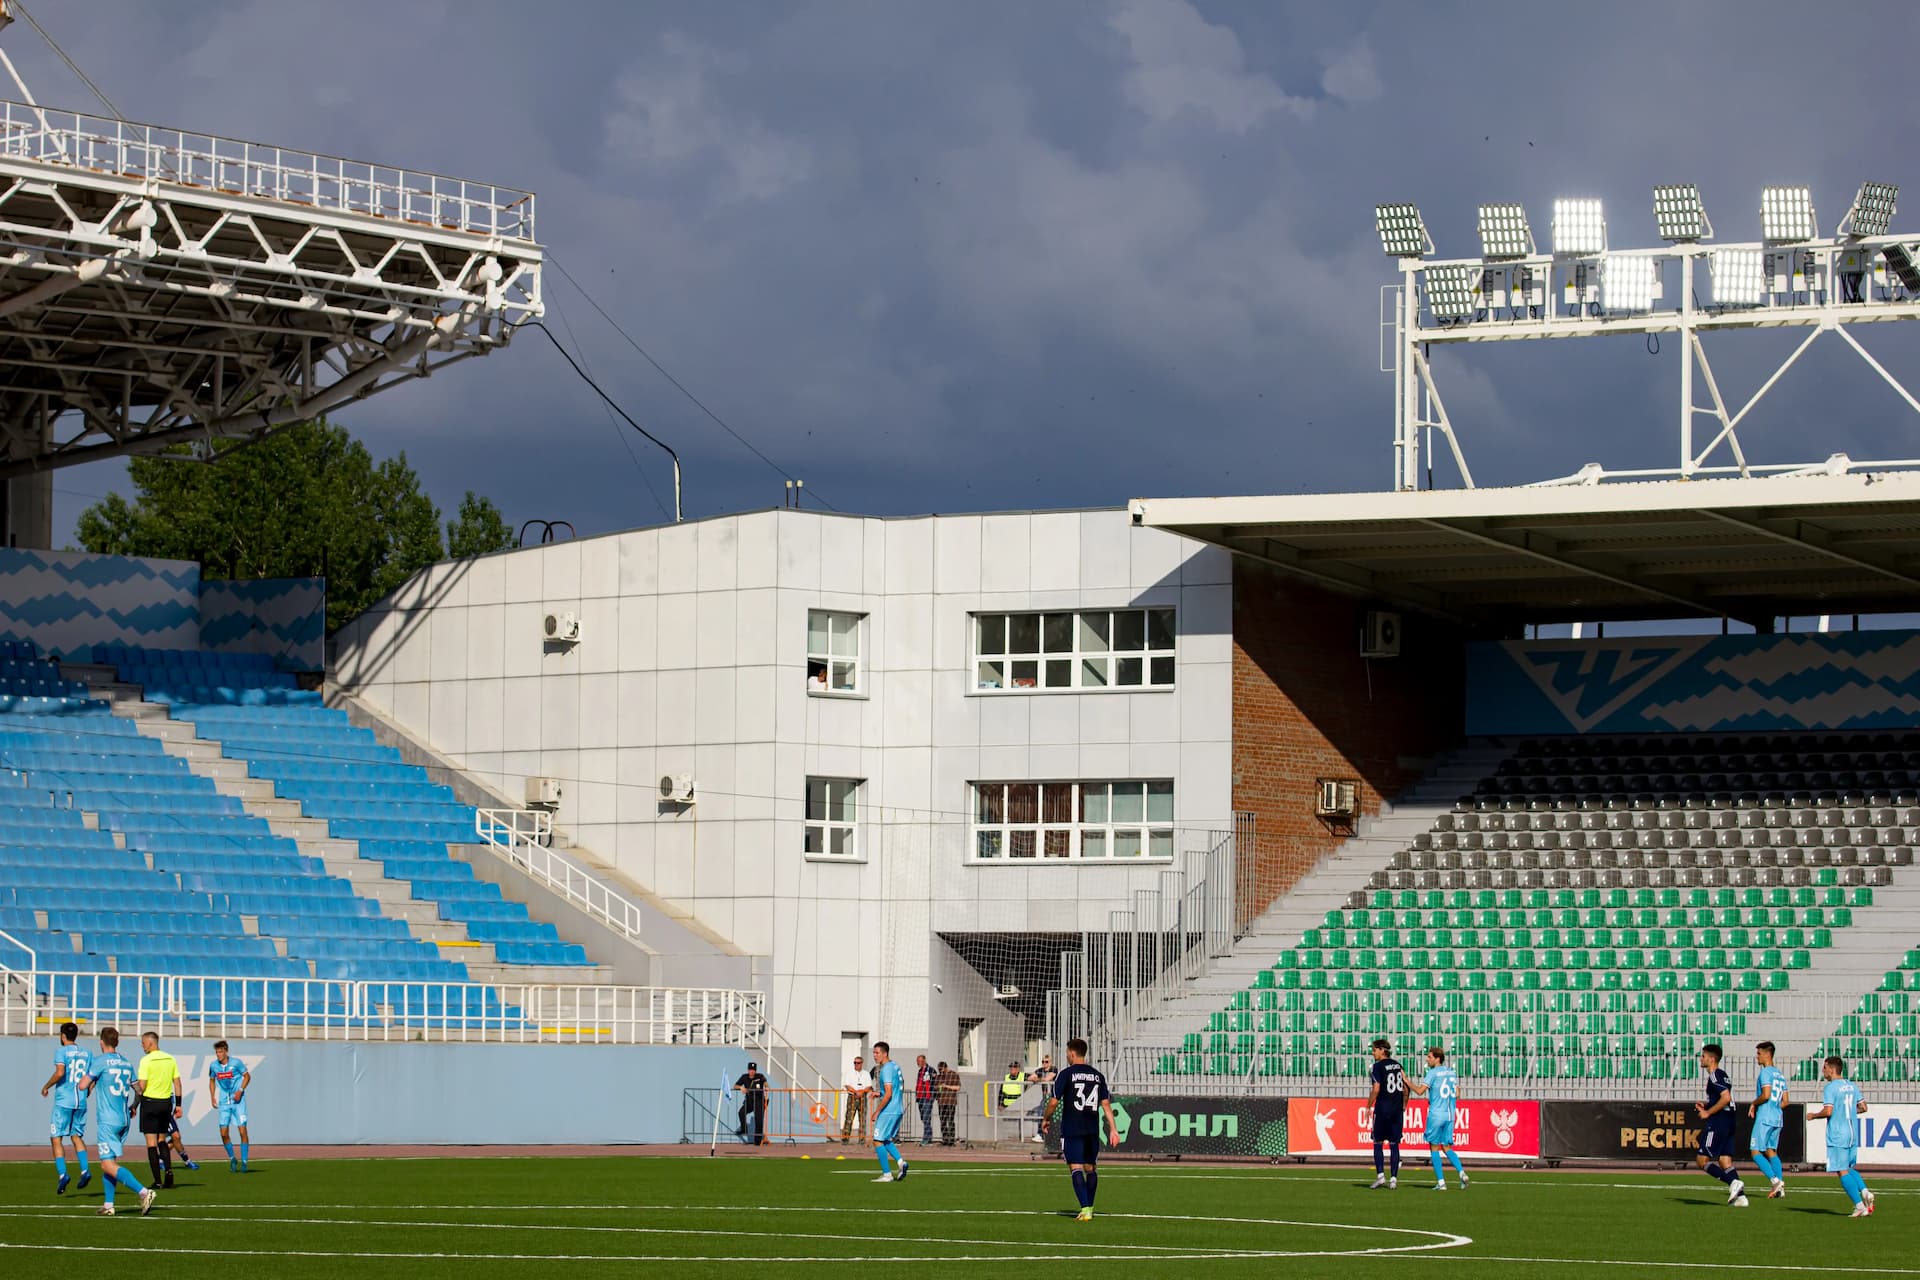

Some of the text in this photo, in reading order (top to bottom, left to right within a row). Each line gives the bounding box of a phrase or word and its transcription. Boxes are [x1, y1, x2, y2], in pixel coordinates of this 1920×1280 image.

[68, 1058, 86, 1083] 18
[109, 1068, 132, 1097] 33
[1386, 1072, 1403, 1094] 88
[1440, 1077, 1457, 1099] 63
[1073, 1083, 1099, 1112] 34
[1139, 1111, 1239, 1139] ФНЛ
[1403, 1107, 1424, 1129] НА
[1654, 1111, 1686, 1125] THE
[98, 1142, 110, 1155] 33
[1620, 1127, 1702, 1149] PECHK
